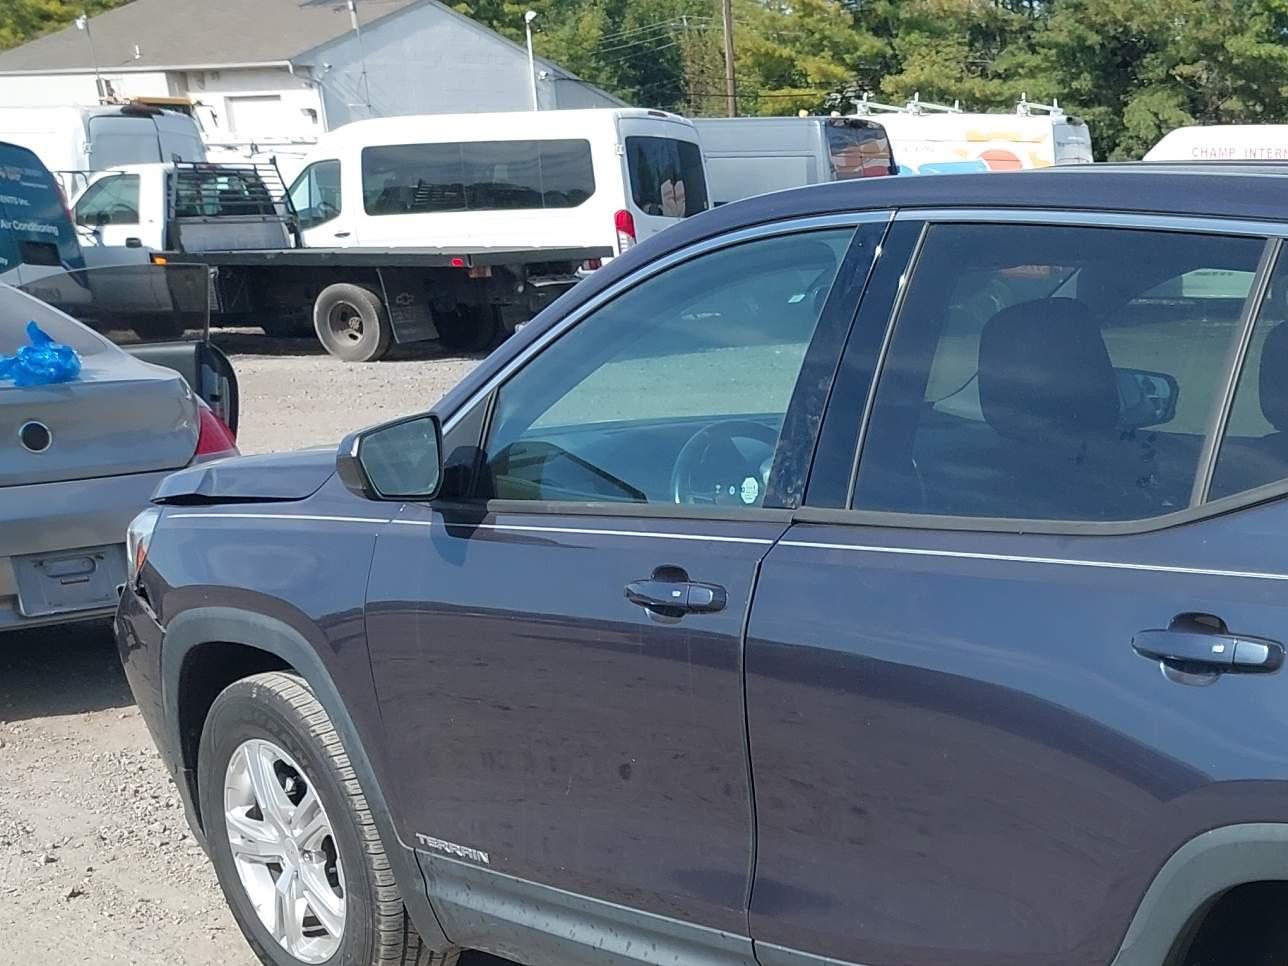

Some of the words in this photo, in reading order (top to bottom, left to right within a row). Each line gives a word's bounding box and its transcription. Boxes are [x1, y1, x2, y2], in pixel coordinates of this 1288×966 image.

[1191, 146, 1236, 158] CHAMP
[12, 220, 59, 236] Conditioning
[415, 832, 491, 864] TERRAIN
